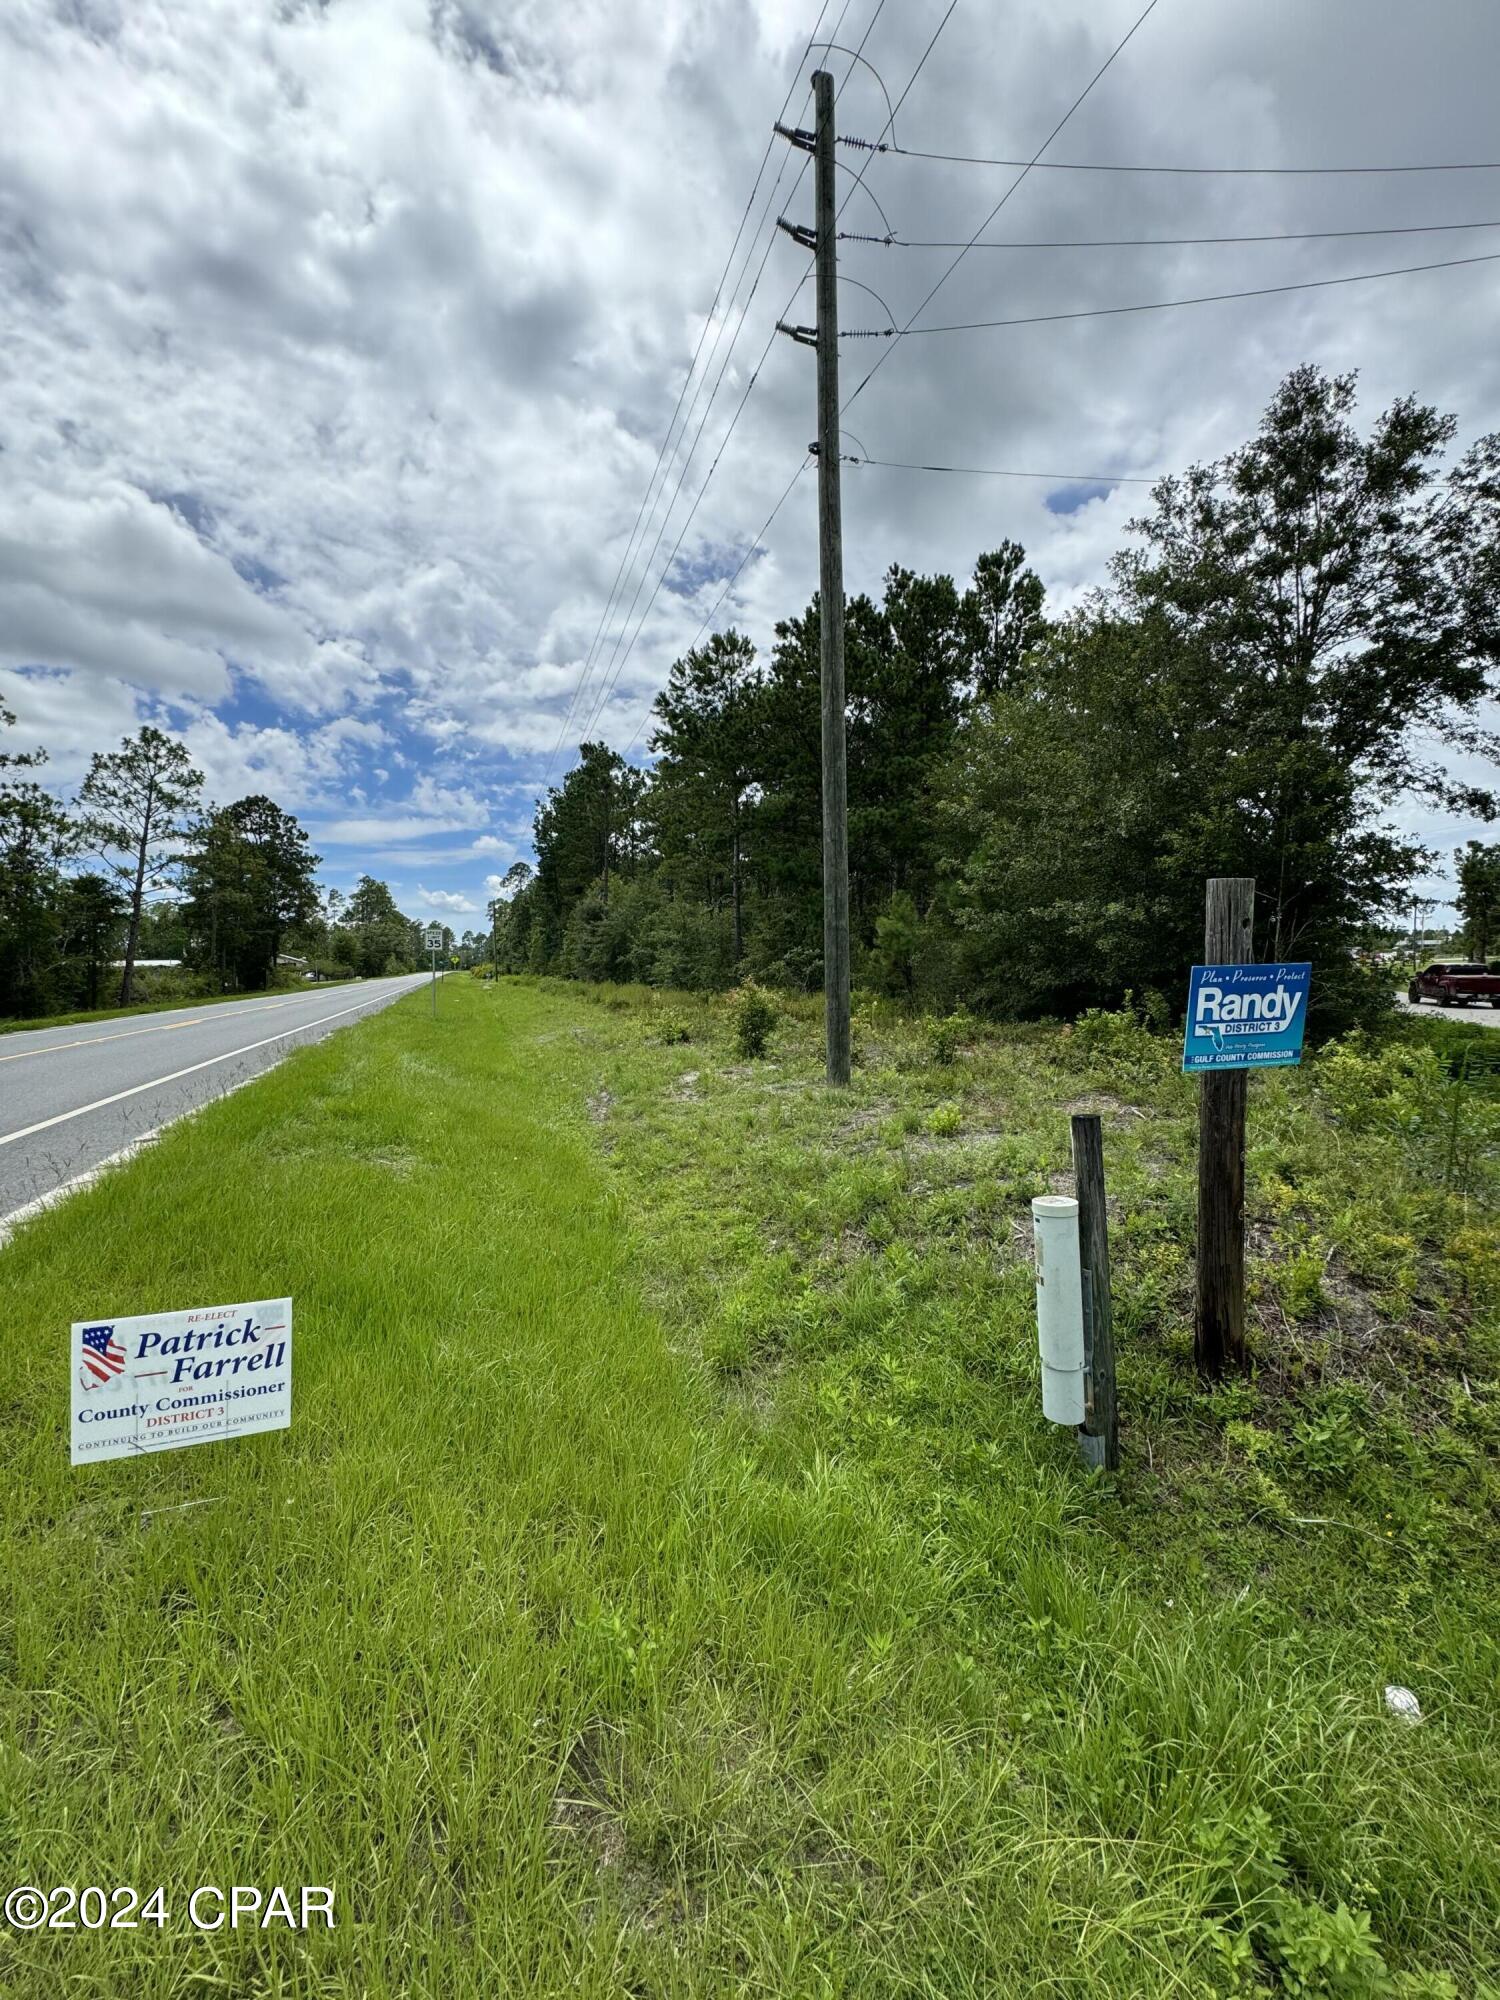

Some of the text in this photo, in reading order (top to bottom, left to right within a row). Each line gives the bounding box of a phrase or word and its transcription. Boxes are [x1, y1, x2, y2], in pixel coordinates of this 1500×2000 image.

[427, 940, 441, 948] 35
[1200, 968, 1306, 984] Plan Preserve Protect
[1195, 984, 1303, 1022] Randy
[1225, 1022, 1280, 1033] DISTRICT 3
[1194, 1050, 1294, 1064] GULF COUNTY COMMISSION
[187, 1310, 238, 1323] RE-ELECT
[134, 1318, 262, 1359] Patrick
[170, 1342, 286, 1384] Farrell
[78, 1381, 286, 1424] County Commissioner
[146, 1406, 225, 1428] DISTRICT 3
[78, 1410, 286, 1450] CONTINUING TO BUILD OUR COMMUNITY
